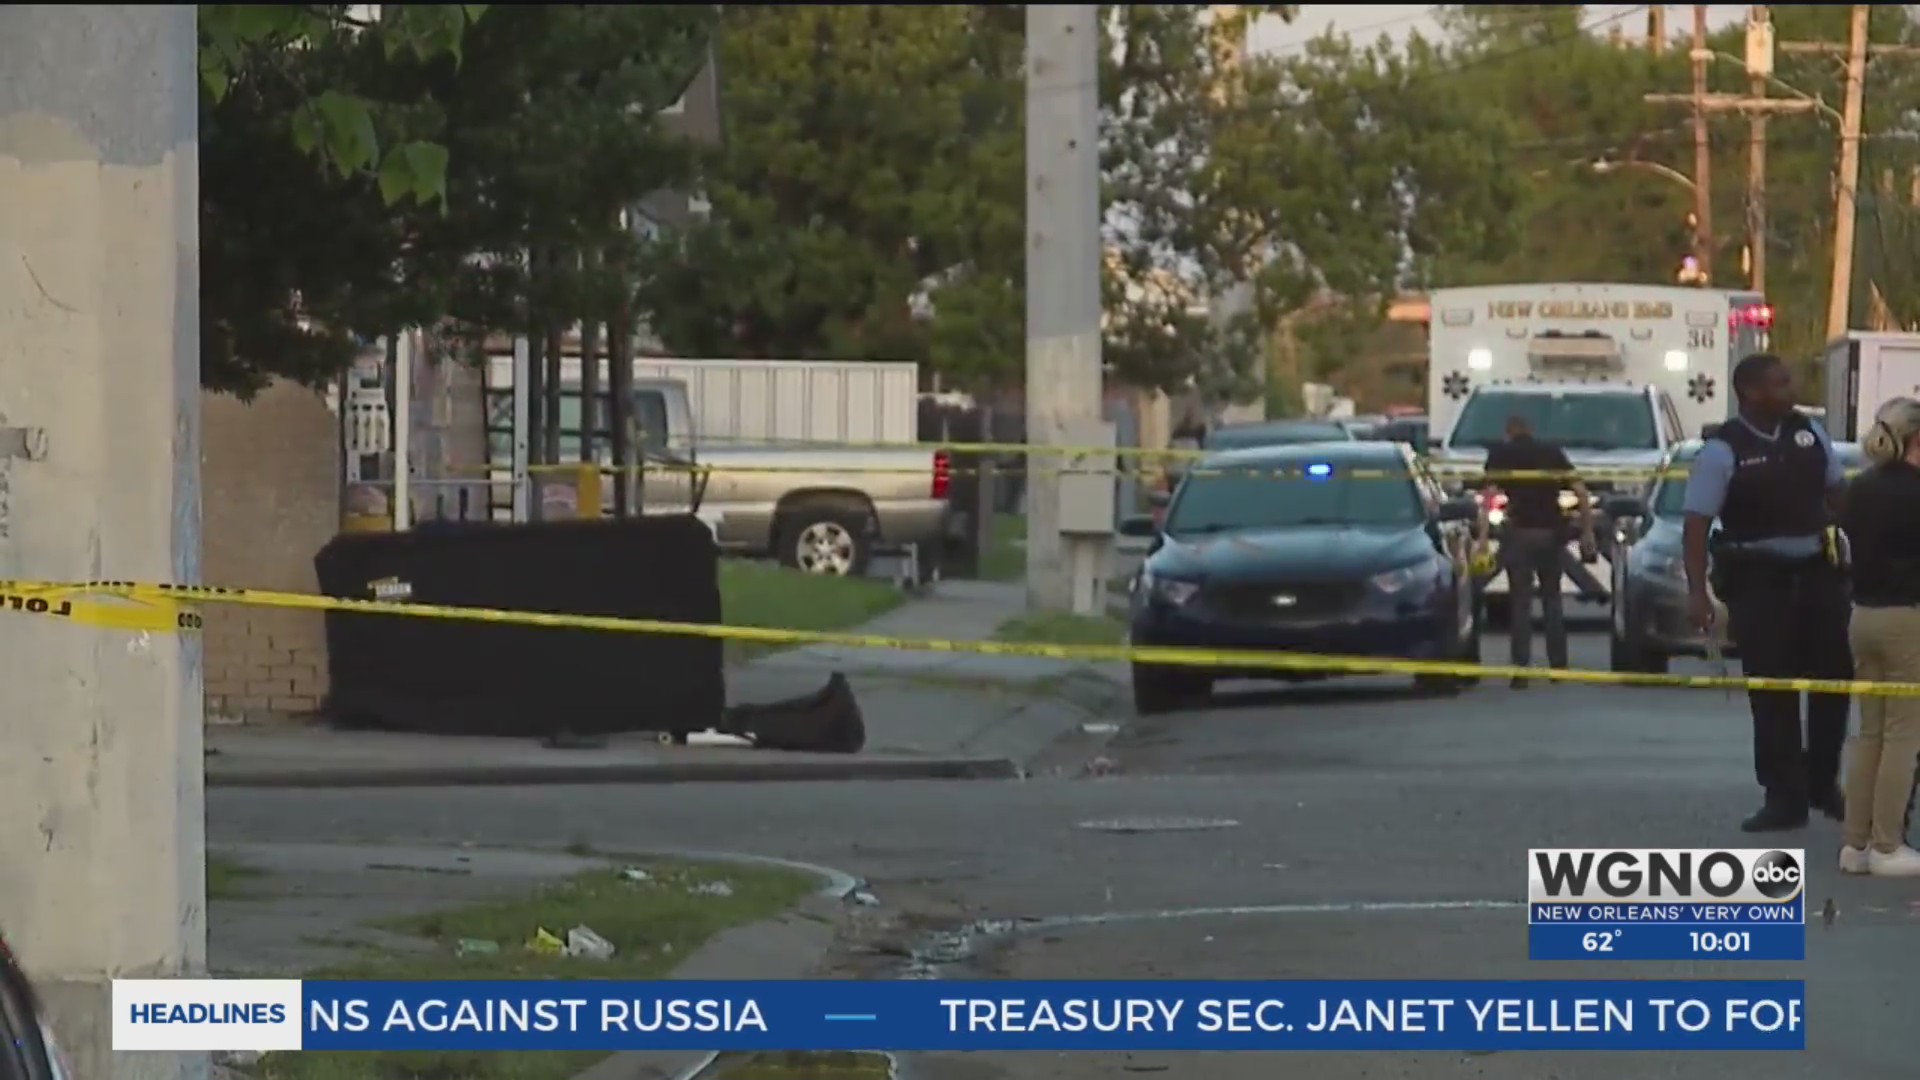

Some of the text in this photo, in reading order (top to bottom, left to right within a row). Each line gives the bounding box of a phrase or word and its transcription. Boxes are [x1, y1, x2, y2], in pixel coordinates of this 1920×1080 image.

[1487, 300, 1533, 319] NEW
[1538, 300, 1629, 319] ORLEANS
[1686, 329, 1715, 350] 36
